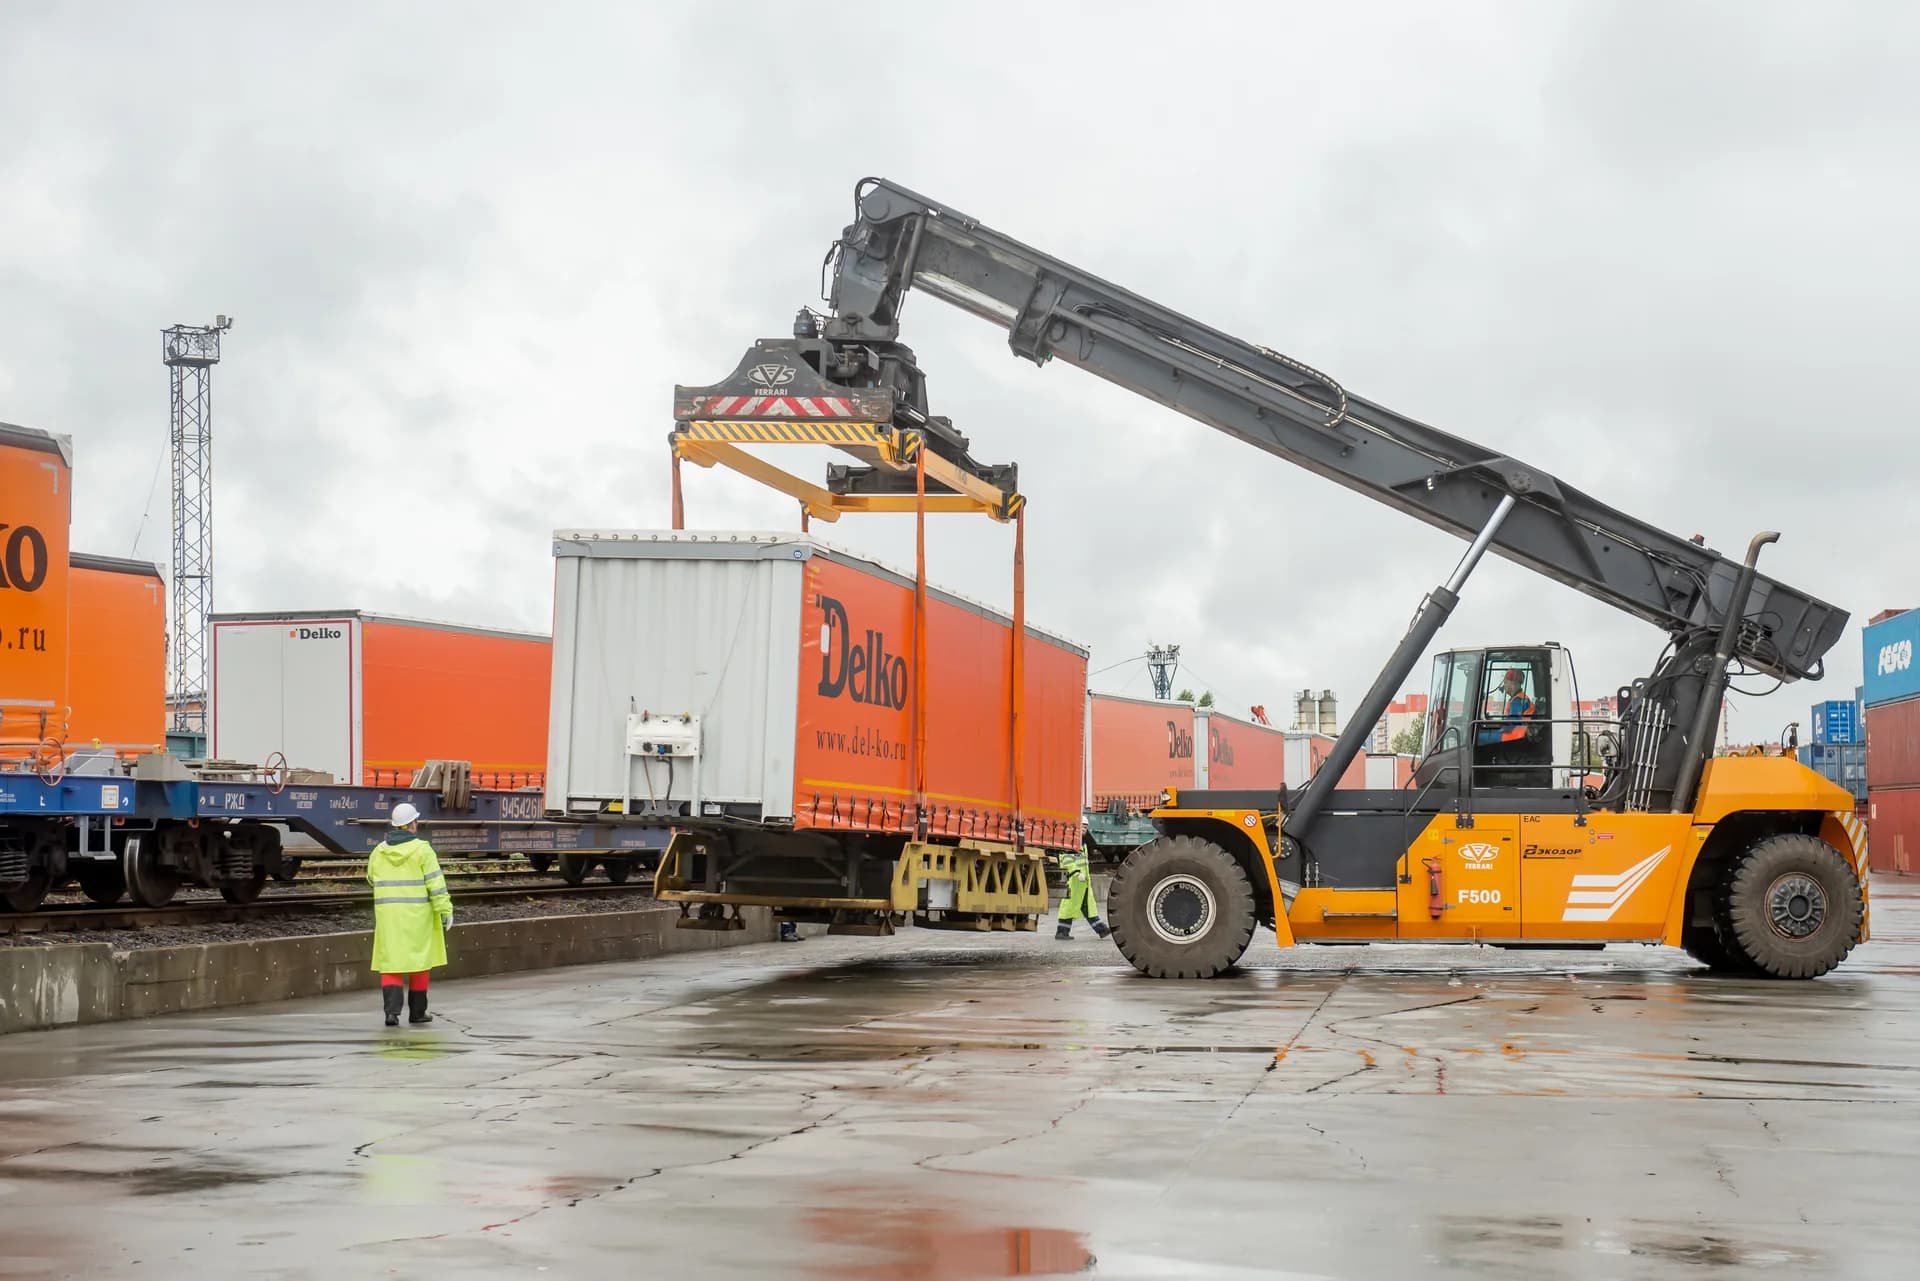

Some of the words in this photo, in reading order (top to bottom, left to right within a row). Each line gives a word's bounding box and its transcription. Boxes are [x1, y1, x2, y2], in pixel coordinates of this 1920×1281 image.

[748, 363, 797, 388] CVS
[755, 388, 788, 396] FERRARI
[299, 628, 342, 640] Delko
[816, 593, 907, 711] Delko
[816, 725, 906, 761] www.del-ko.ru
[1167, 720, 1193, 759] Delko
[225, 792, 245, 810] РЖД
[1523, 815, 1541, 823] EAC
[1458, 842, 1500, 865] CVS
[1458, 889, 1501, 904] F500
